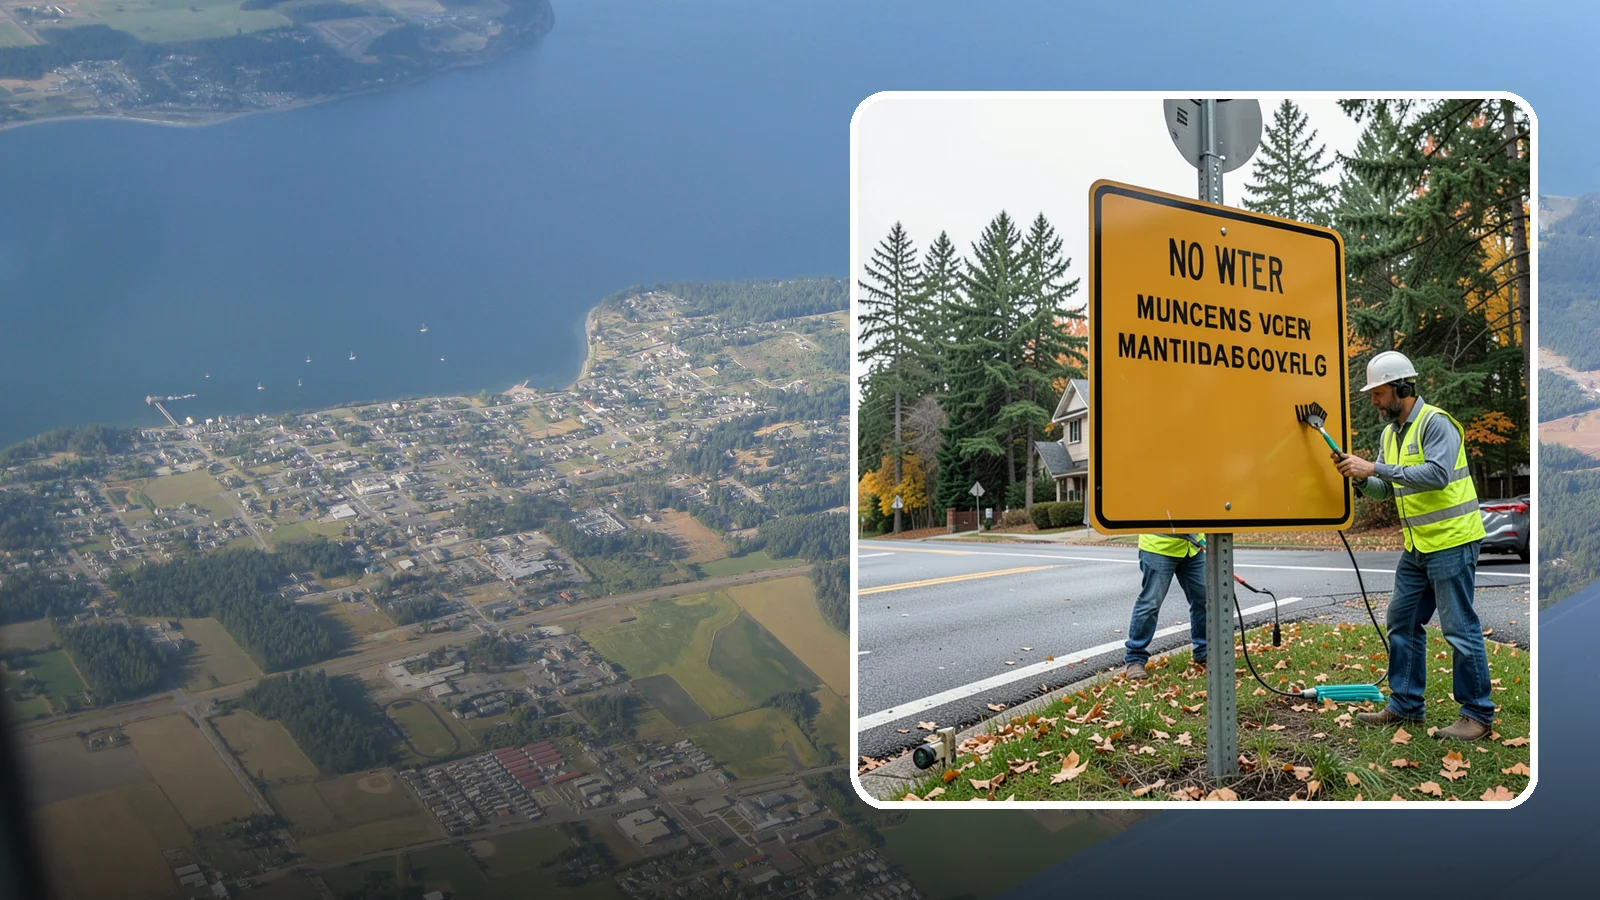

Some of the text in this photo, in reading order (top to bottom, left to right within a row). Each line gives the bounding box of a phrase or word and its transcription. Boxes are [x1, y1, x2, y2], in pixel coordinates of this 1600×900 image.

[1169, 238, 1284, 294] NO WTER
[1137, 293, 1252, 333] MUNCENS
